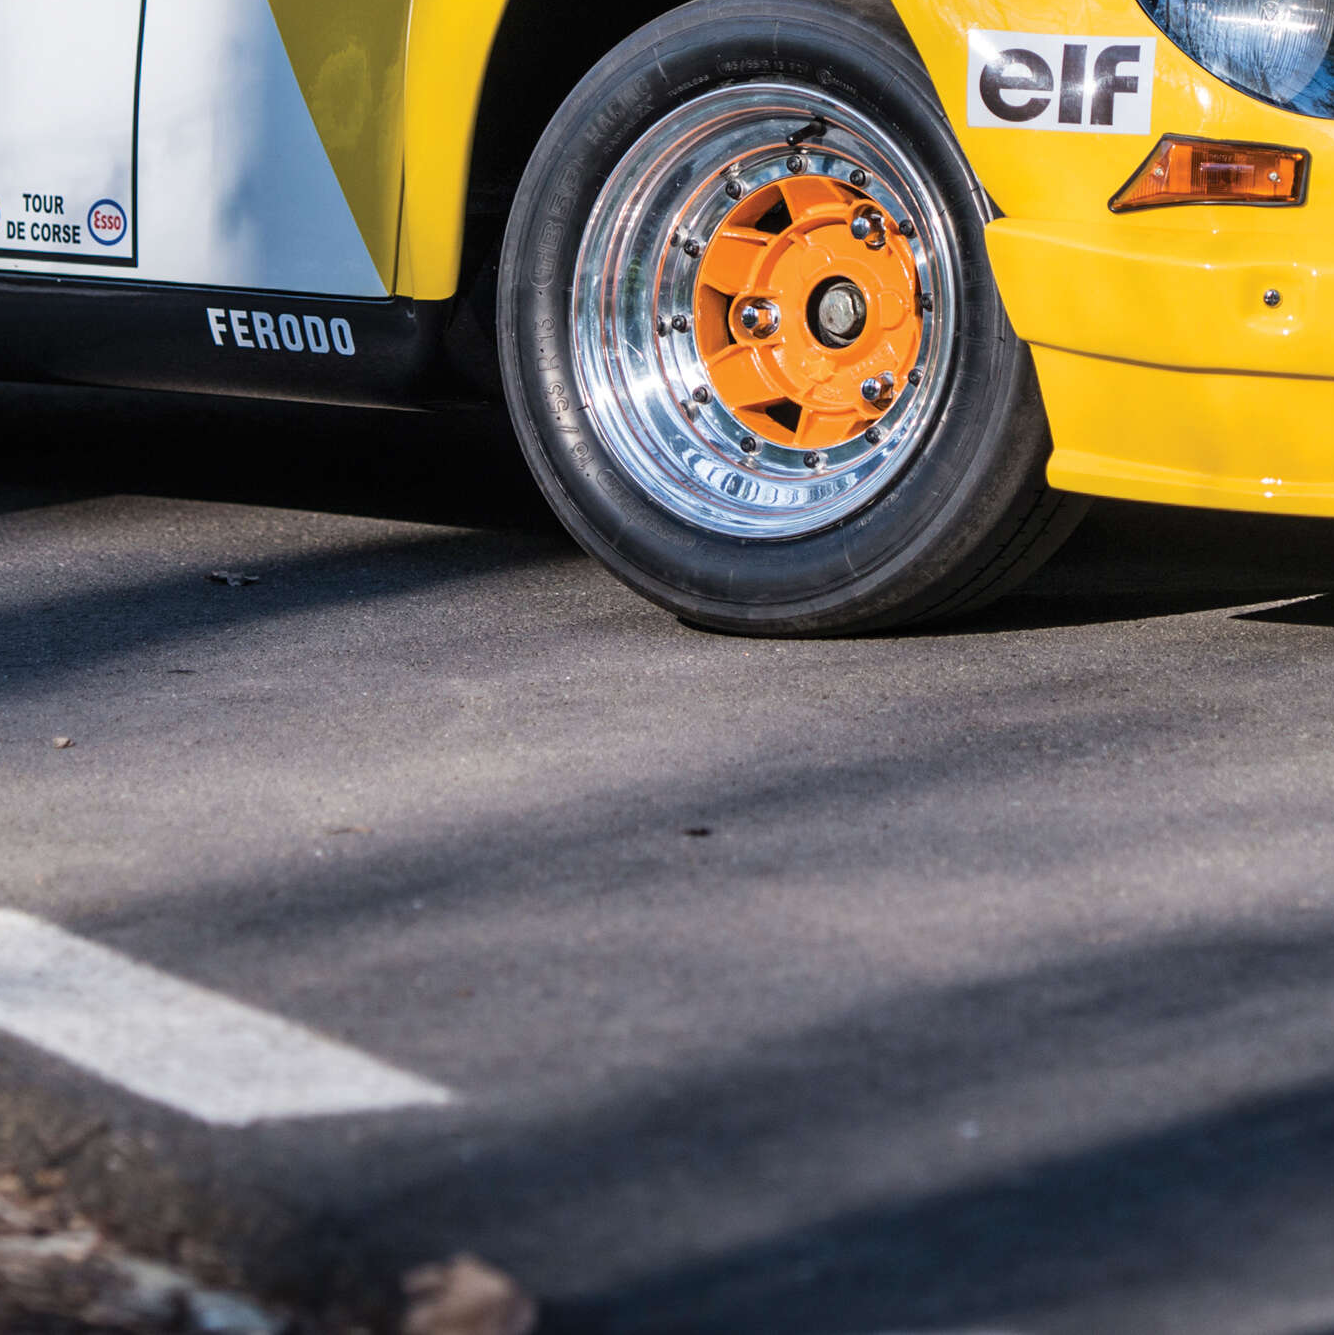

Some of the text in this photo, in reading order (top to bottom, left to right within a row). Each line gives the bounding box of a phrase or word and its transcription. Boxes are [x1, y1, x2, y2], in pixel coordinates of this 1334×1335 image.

[979, 43, 1141, 126] elf
[23, 194, 64, 214] TOUR
[94, 211, 121, 230] Esso
[7, 221, 81, 244] DE CORSE
[207, 308, 355, 356] FERODO
